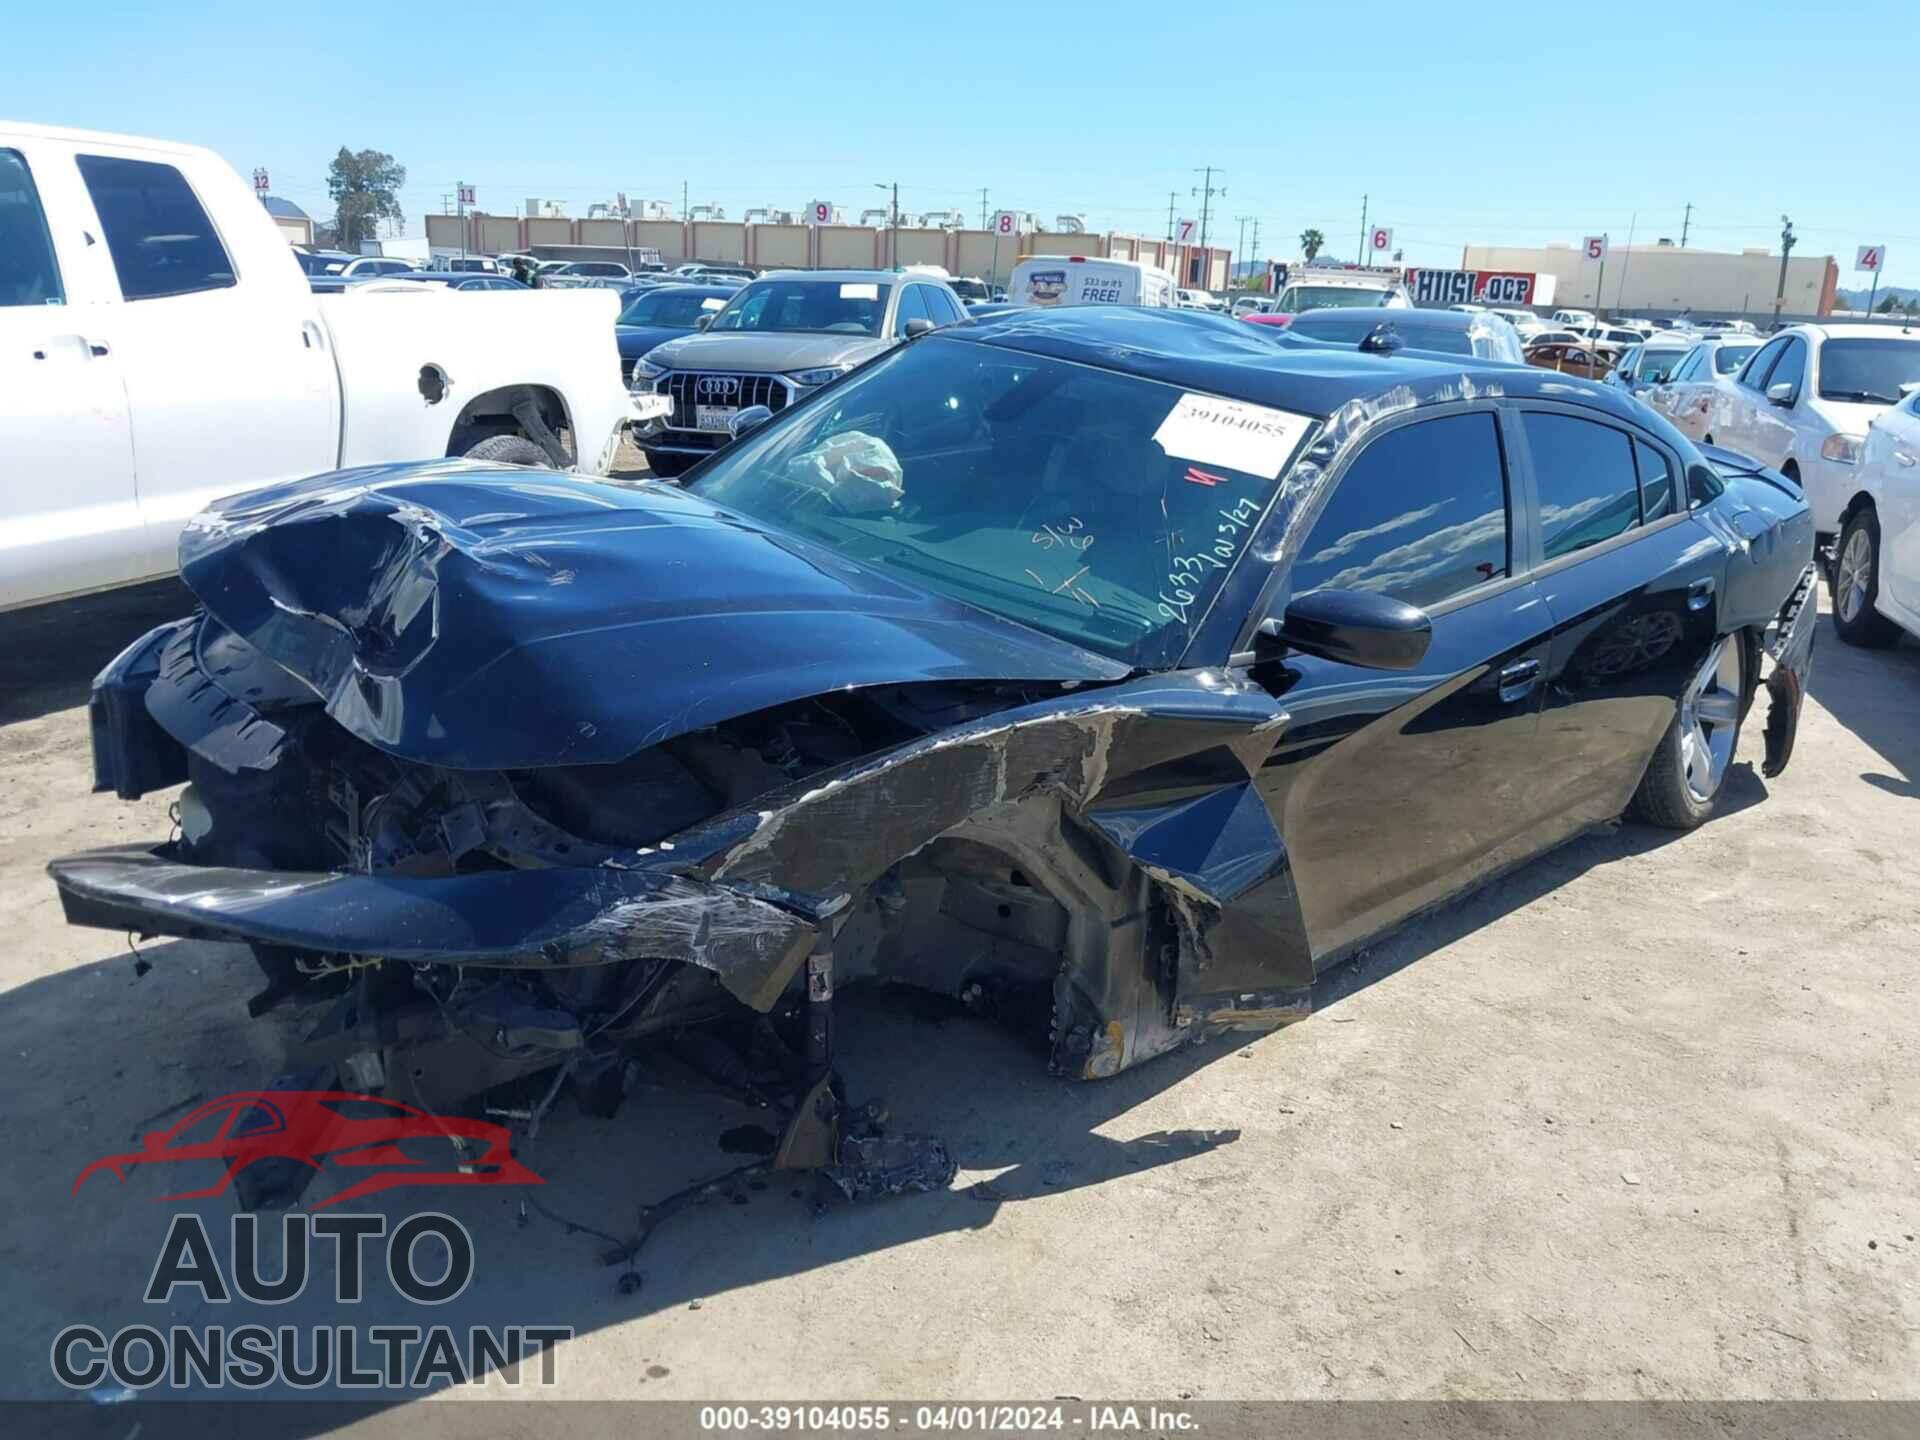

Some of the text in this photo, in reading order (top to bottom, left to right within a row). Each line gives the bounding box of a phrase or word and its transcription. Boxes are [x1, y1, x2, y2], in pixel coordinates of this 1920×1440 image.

[254, 175, 269, 189] 12
[460, 189, 475, 202] 11
[816, 203, 828, 221] 9
[999, 215, 1012, 233] 8
[1180, 221, 1193, 240] 7
[1374, 230, 1387, 249] 6
[1587, 239, 1603, 258] 5
[1861, 248, 1878, 269] 4
[1081, 287, 1120, 303] FREE!
